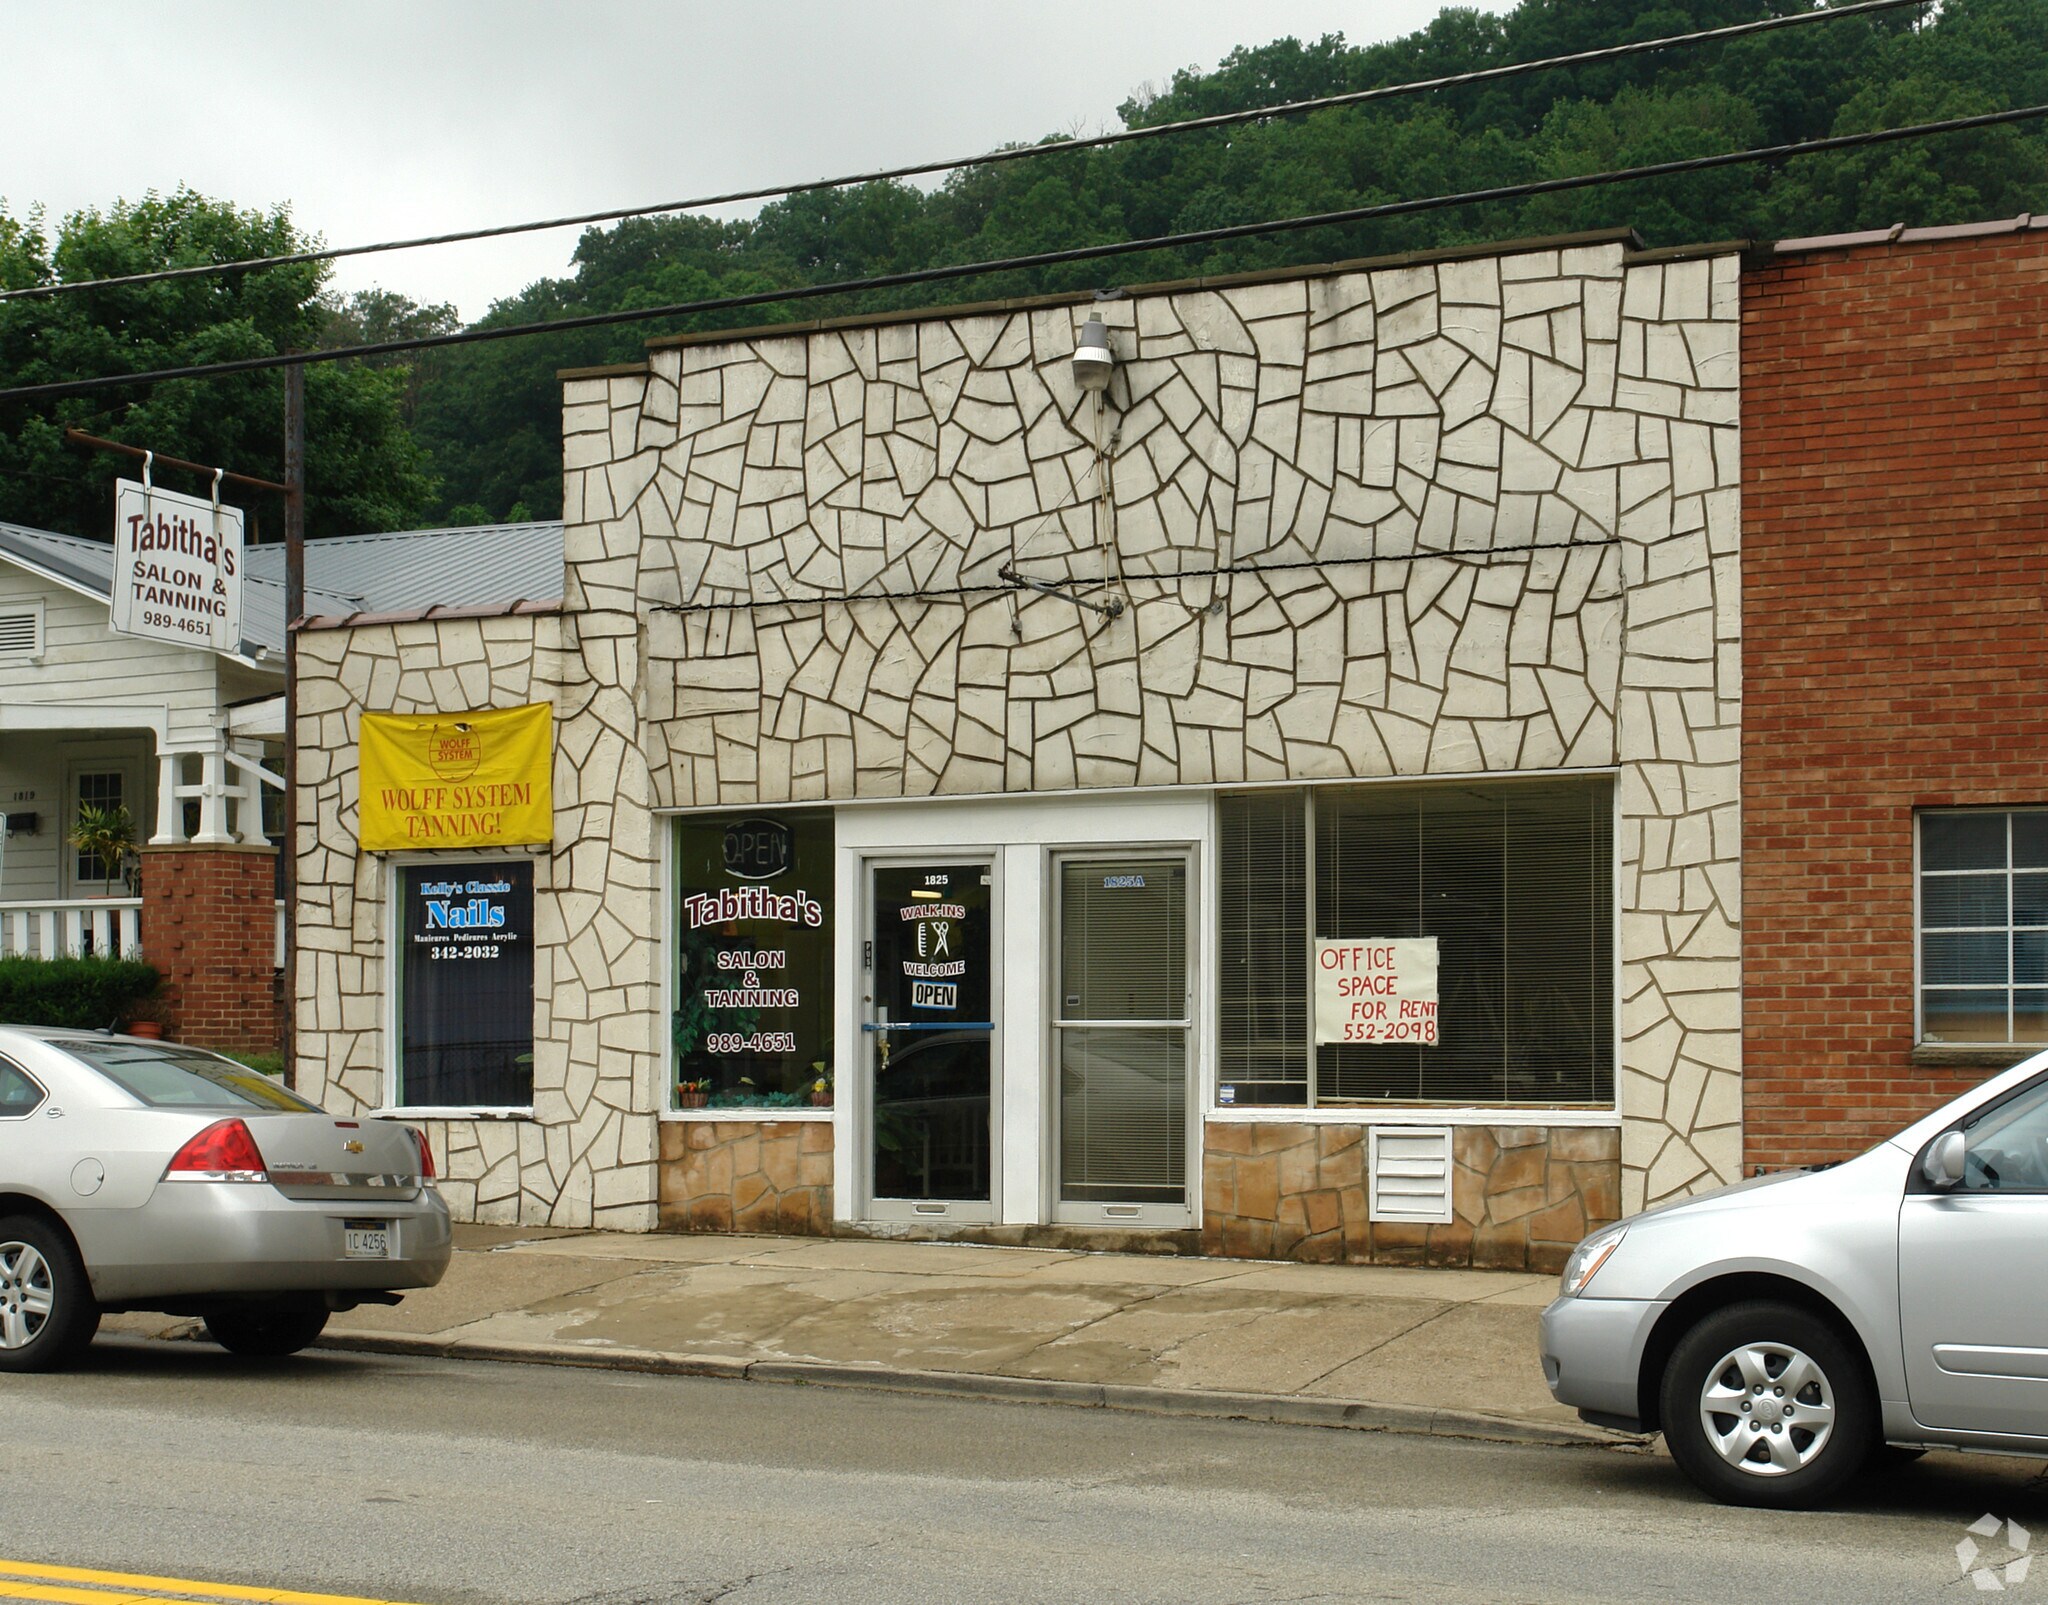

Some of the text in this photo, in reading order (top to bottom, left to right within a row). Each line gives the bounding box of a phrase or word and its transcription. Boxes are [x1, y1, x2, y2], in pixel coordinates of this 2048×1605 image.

[127, 512, 235, 577] Tabitha's
[133, 560, 227, 597] SALON &
[132, 582, 226, 618] TANNING
[143, 611, 212, 636] 989-4651
[439, 738, 471, 750] WOLFF
[438, 749, 473, 761] SYSTEM
[381, 782, 531, 811] WOLFF SYSTEM
[405, 812, 502, 838] TANNING!
[723, 832, 786, 865] OPEN
[420, 880, 511, 897] Kelly's Classic
[924, 875, 949, 886] 1825
[1104, 875, 1145, 888] 1825A
[425, 899, 505, 929] Nails
[684, 886, 822, 929] Tabitha's
[900, 904, 966, 921] WALK-INS
[414, 932, 517, 942] Manicures Pedicures Acrylic
[431, 945, 500, 959] 342-2032
[717, 950, 785, 969] SALON
[1320, 947, 1396, 971] OFFICE
[903, 960, 966, 977] WELCOME
[743, 970, 760, 988] &
[1338, 975, 1398, 996] SPACE
[705, 989, 799, 1008] TANNING
[916, 984, 954, 1006] OPEN
[1351, 999, 1437, 1020] FOR RENT
[1344, 1020, 1436, 1042] 552-2098
[707, 1032, 796, 1052] 989-4651
[362, 1233, 387, 1249] 4256
